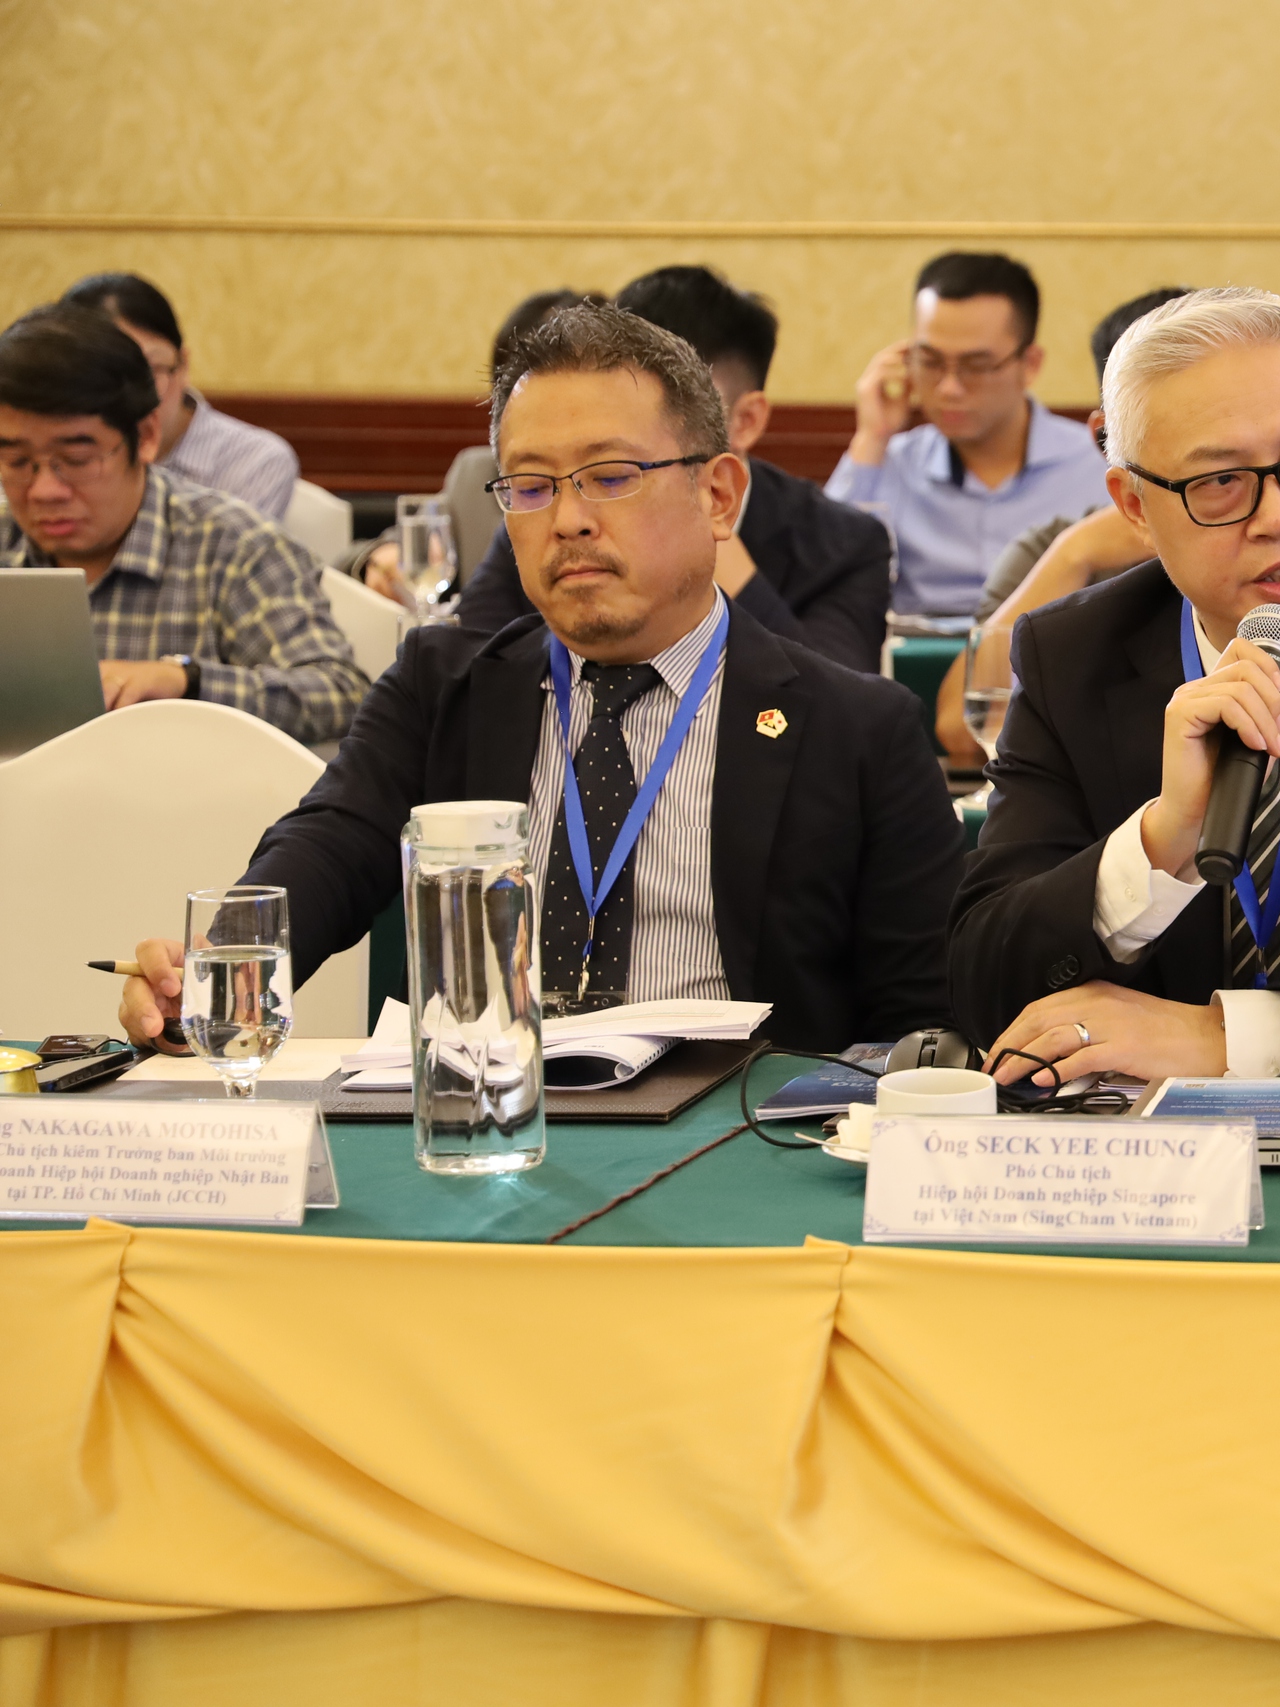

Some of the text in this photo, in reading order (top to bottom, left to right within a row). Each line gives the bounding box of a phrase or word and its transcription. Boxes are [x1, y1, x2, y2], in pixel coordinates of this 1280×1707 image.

[0, 1118, 278, 1141] g NAKAGAWA MOTOHISA
[31, 1144, 58, 1160] tịch
[63, 1144, 99, 1158] kiêm
[167, 1147, 195, 1160] ban
[200, 1148, 230, 1162] Môi
[924, 1129, 1196, 1158] Ông SECK YEE CHUNG
[41, 1165, 76, 1182] Hiệp
[81, 1166, 104, 1182] hội
[109, 1166, 158, 1180] Doanh
[163, 1168, 214, 1185] nghiệp
[219, 1169, 255, 1186] Nhật
[260, 1170, 289, 1184] Bản
[1005, 1163, 1111, 1183] Phó Chủ tịch
[7, 1185, 27, 1201] tại
[32, 1185, 57, 1200] TP.
[89, 1186, 117, 1201] Chí
[121, 1188, 161, 1202] Minh
[167, 1189, 226, 1206] (JCCH)
[919, 1184, 1196, 1207] Hiệp hội Doanh nghiệp Singapore
[914, 1207, 1197, 1229] tại Việt Nam (SingCham Vietnam)
